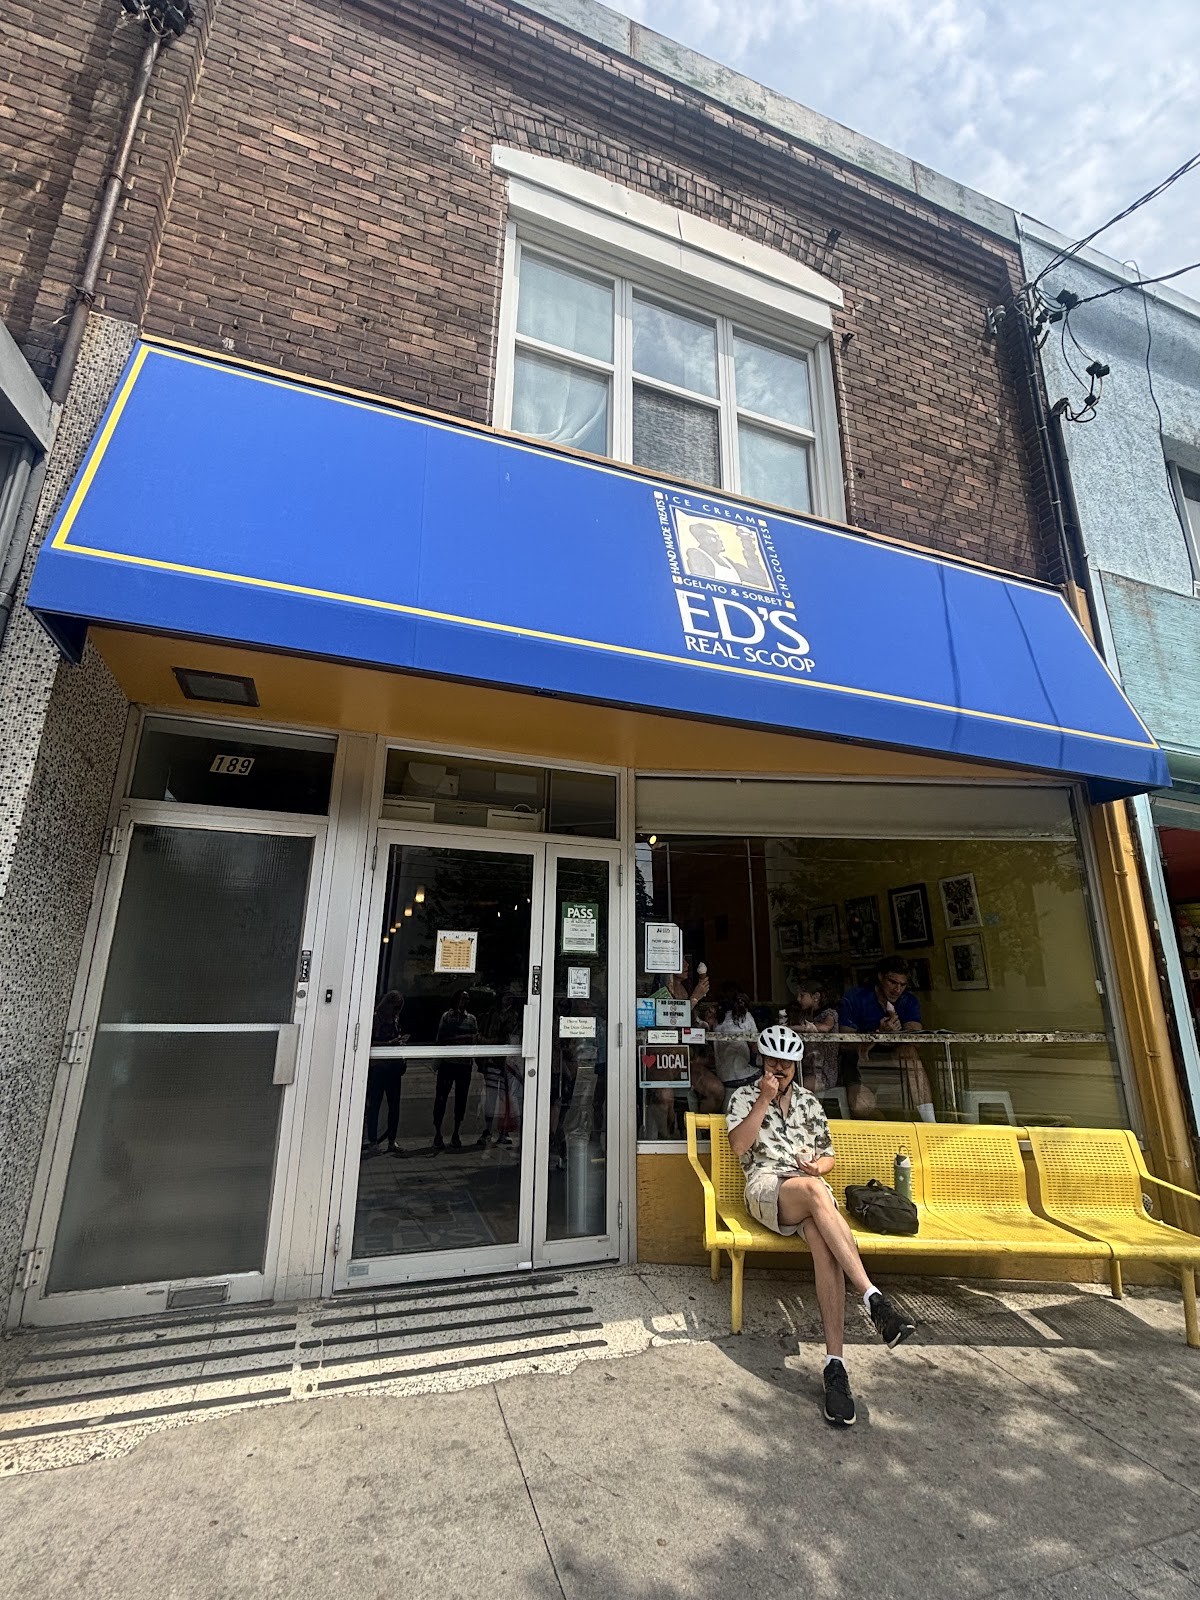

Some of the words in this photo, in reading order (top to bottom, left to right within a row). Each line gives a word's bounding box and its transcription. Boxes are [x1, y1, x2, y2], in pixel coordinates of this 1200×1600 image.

[655, 499, 670, 527] TREATS
[664, 493, 692, 507] ICE
[702, 504, 756, 525] CREAM
[662, 525, 675, 551] MADE
[667, 549, 681, 575] HAND
[760, 528, 791, 599] CHOCOLATES
[683, 578, 728, 594] GELATO
[730, 588, 740, 597] &
[742, 591, 783, 607] SORBET
[675, 588, 810, 656] ED'S
[685, 635, 740, 660] REAL
[743, 646, 816, 673] SCOOP
[215, 756, 251, 774] 189
[567, 907, 594, 919] PASS
[656, 1054, 688, 1070] LOCAL
